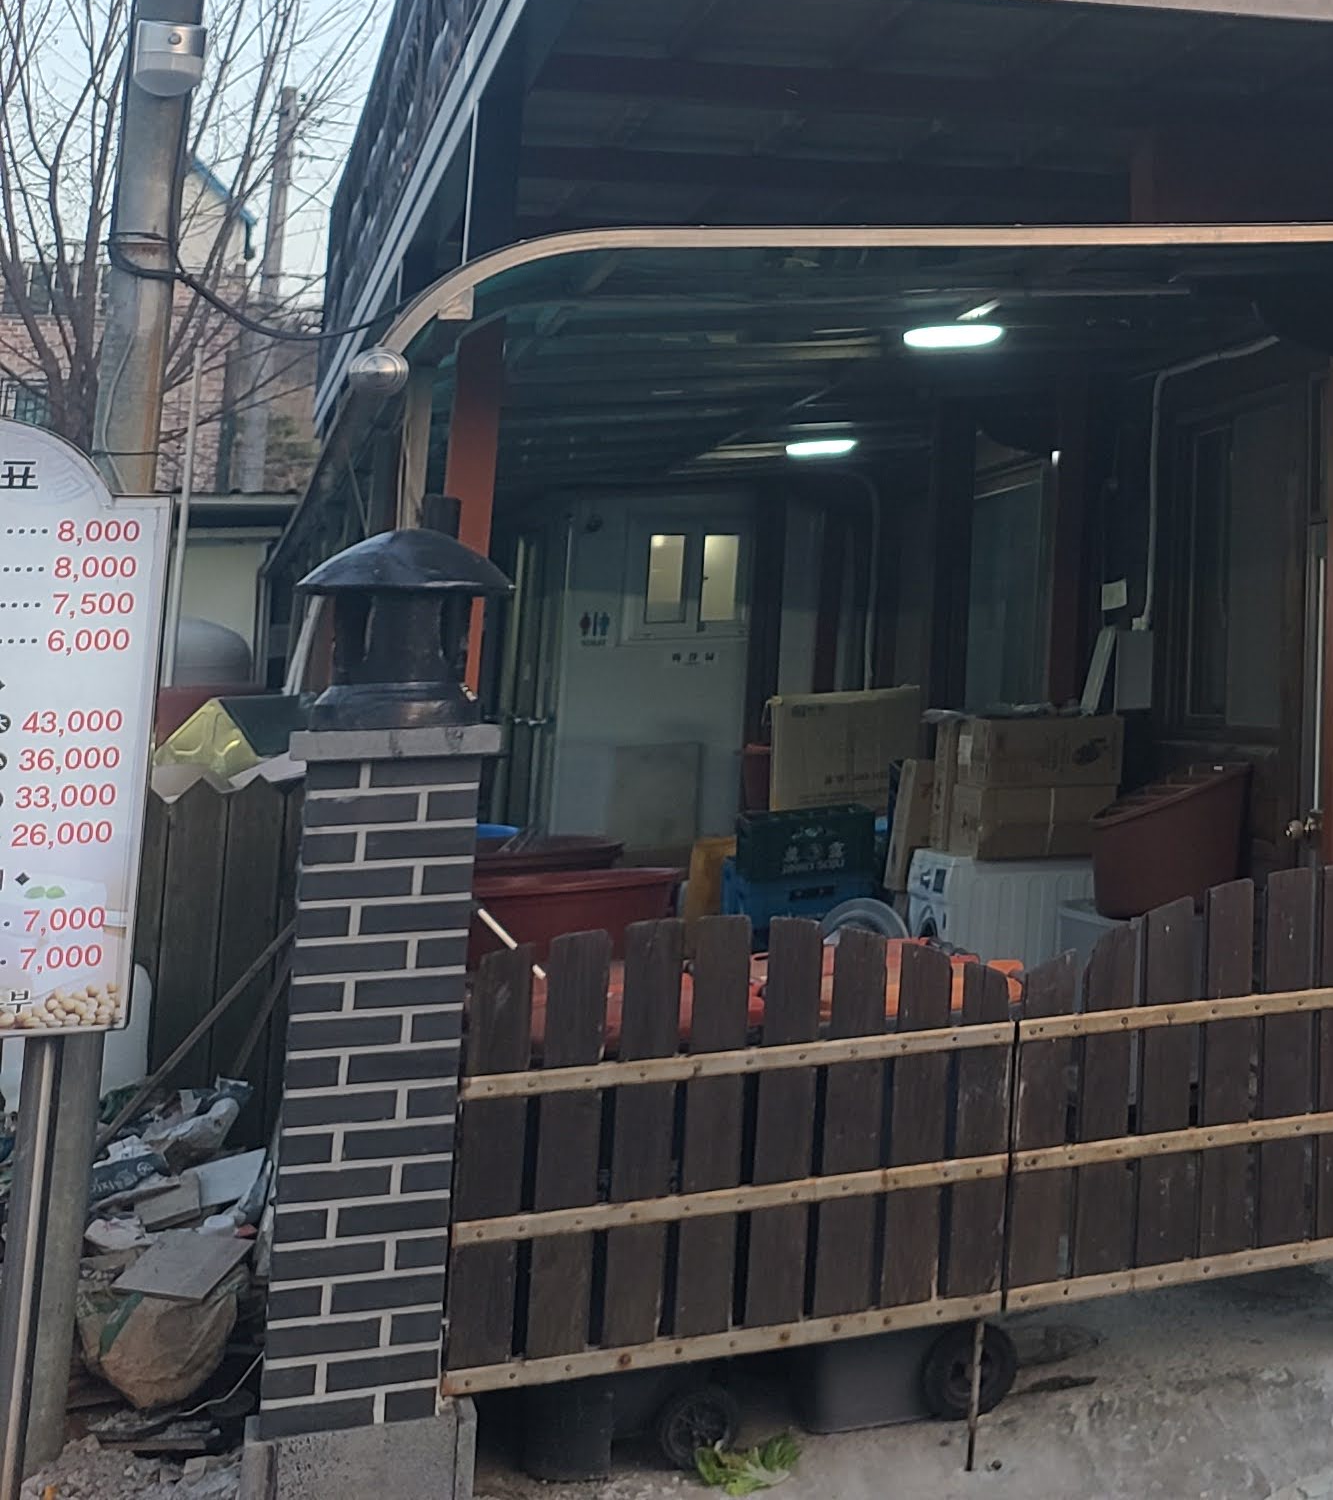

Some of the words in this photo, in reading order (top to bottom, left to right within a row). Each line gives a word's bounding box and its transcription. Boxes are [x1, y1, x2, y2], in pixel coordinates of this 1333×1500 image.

[0, 460, 39, 489] 표
[57, 520, 141, 546] 8,000
[53, 556, 138, 583] 8,000
[52, 592, 135, 619] 7,500
[47, 628, 131, 656] 6,000
[21, 709, 123, 738] 43,000
[18, 746, 121, 775] 36,000
[15, 783, 117, 812] 33,000
[11, 820, 113, 850] 26,000
[23, 906, 106, 937] 7,000
[19, 944, 103, 975] 7,000
